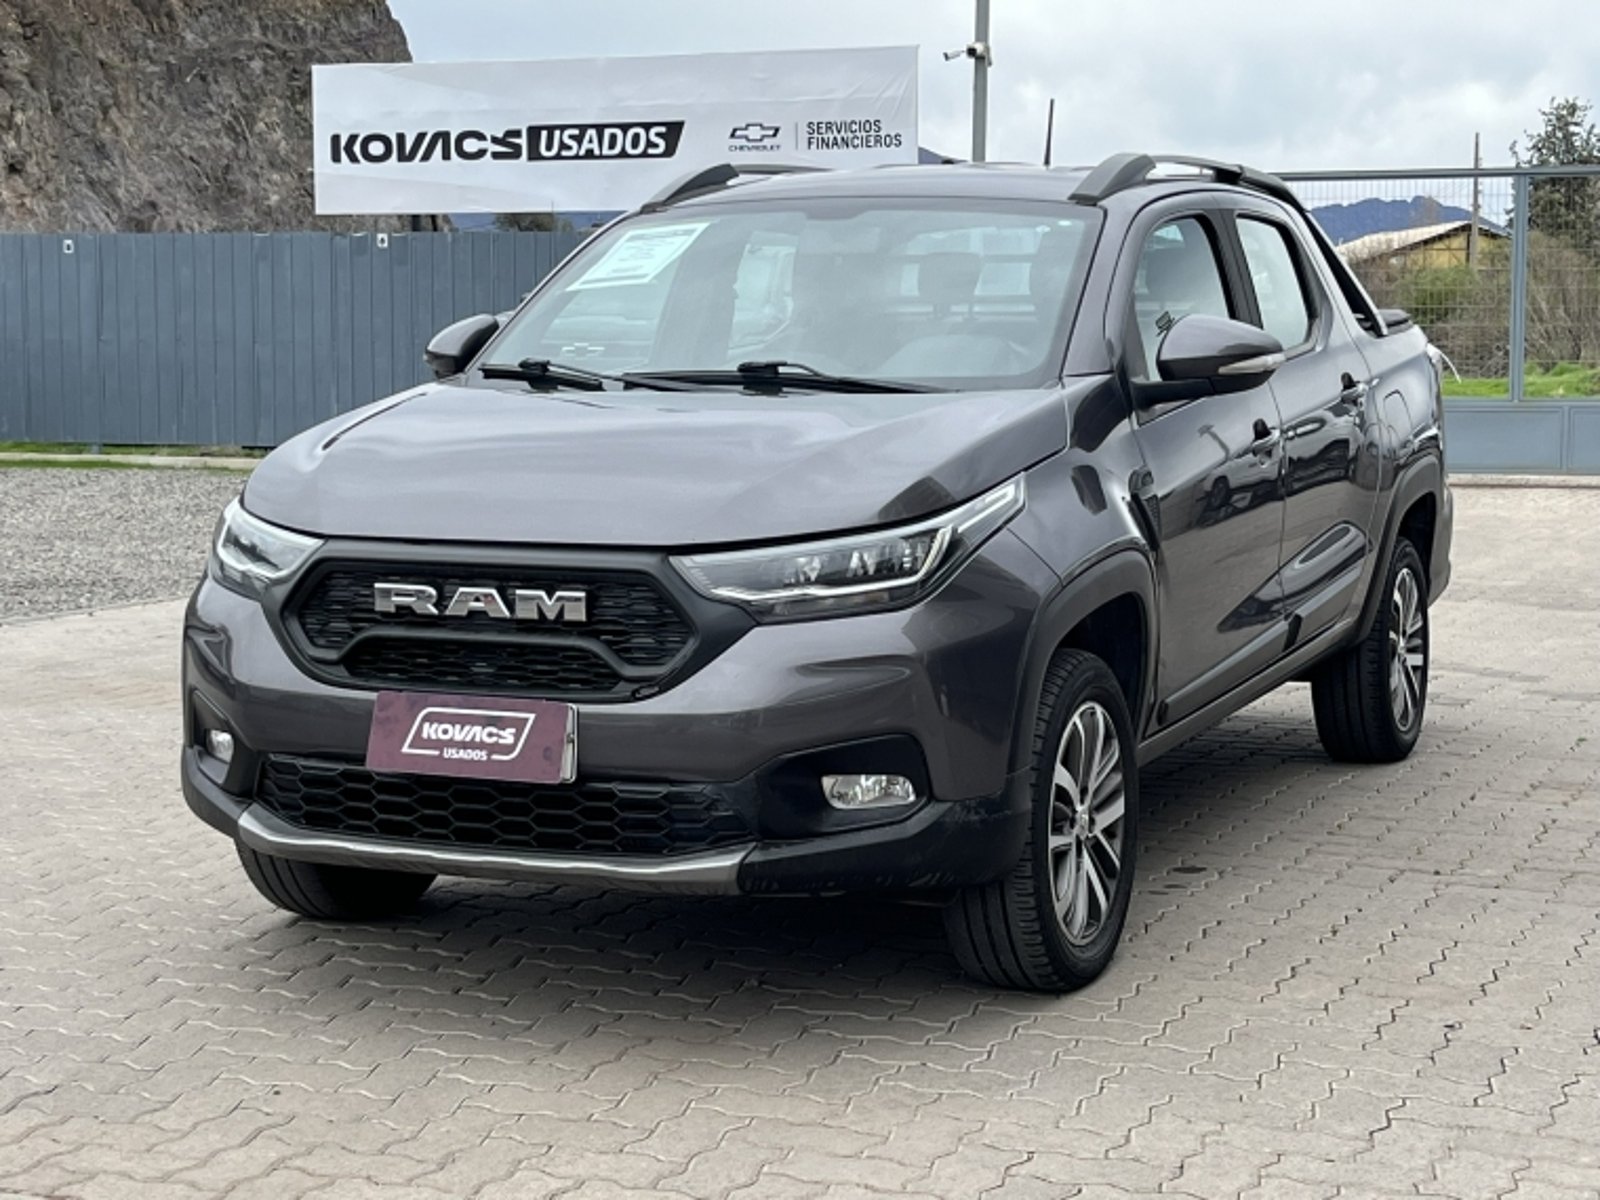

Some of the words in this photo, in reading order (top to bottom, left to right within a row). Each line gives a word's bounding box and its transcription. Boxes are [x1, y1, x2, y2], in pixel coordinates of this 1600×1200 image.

[806, 119, 882, 135] SERVICIOS
[331, 129, 522, 164] KOVACS
[538, 125, 668, 157] USADOS
[728, 144, 782, 152] CHEVROLET
[807, 133, 902, 150] FINANCIEROS
[374, 582, 587, 622] RAM
[421, 721, 517, 745] KOVACS
[443, 747, 488, 761] USADOS
